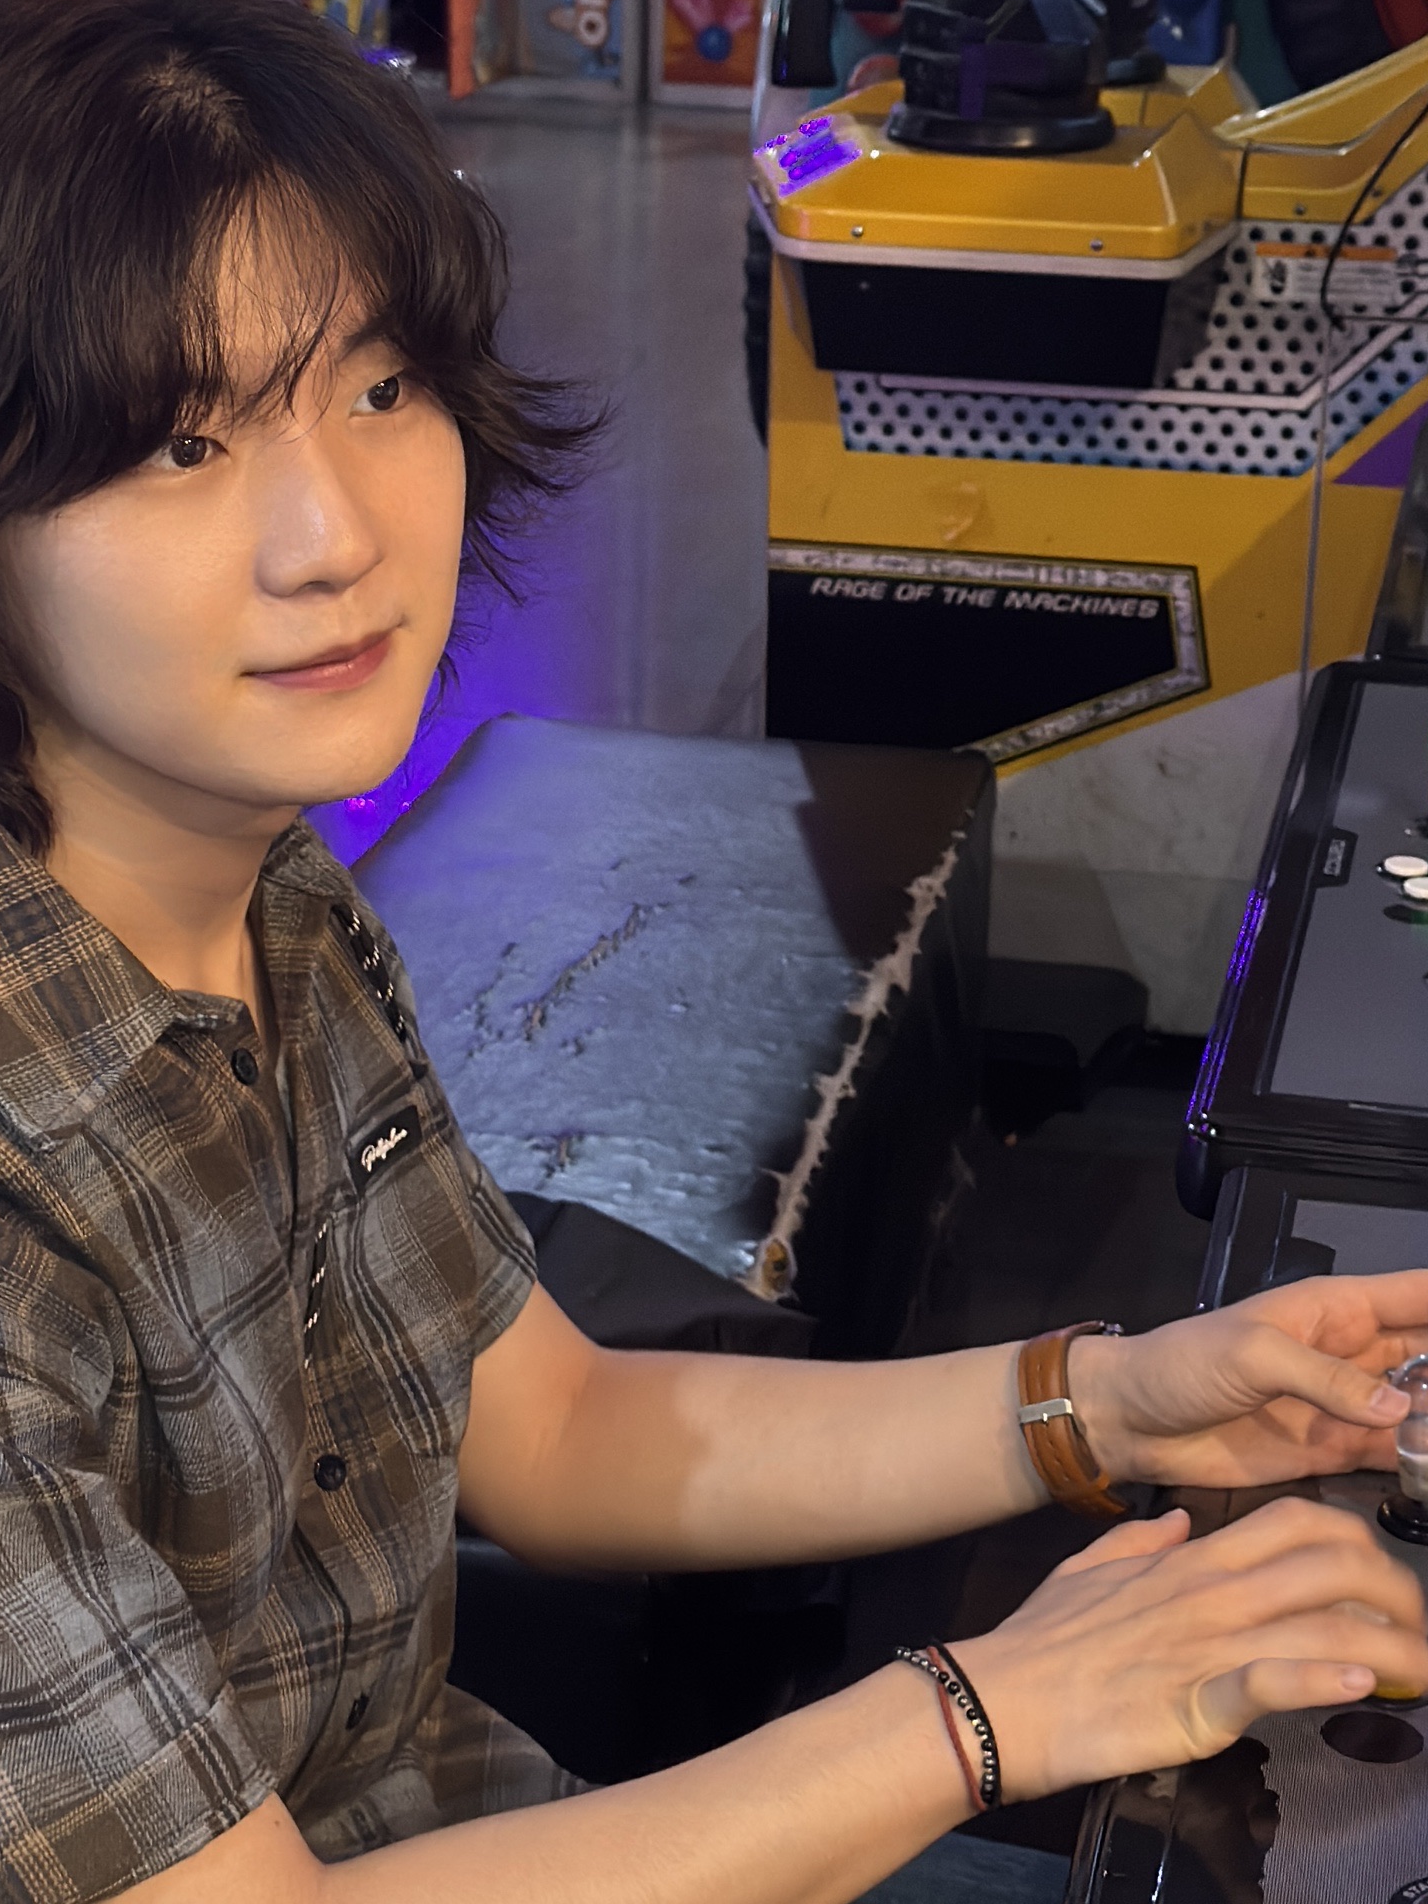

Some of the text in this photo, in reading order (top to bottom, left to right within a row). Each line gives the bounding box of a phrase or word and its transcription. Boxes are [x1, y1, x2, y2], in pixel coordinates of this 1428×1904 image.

[809, 576, 1161, 620] RAGE OF THE MACHINES
